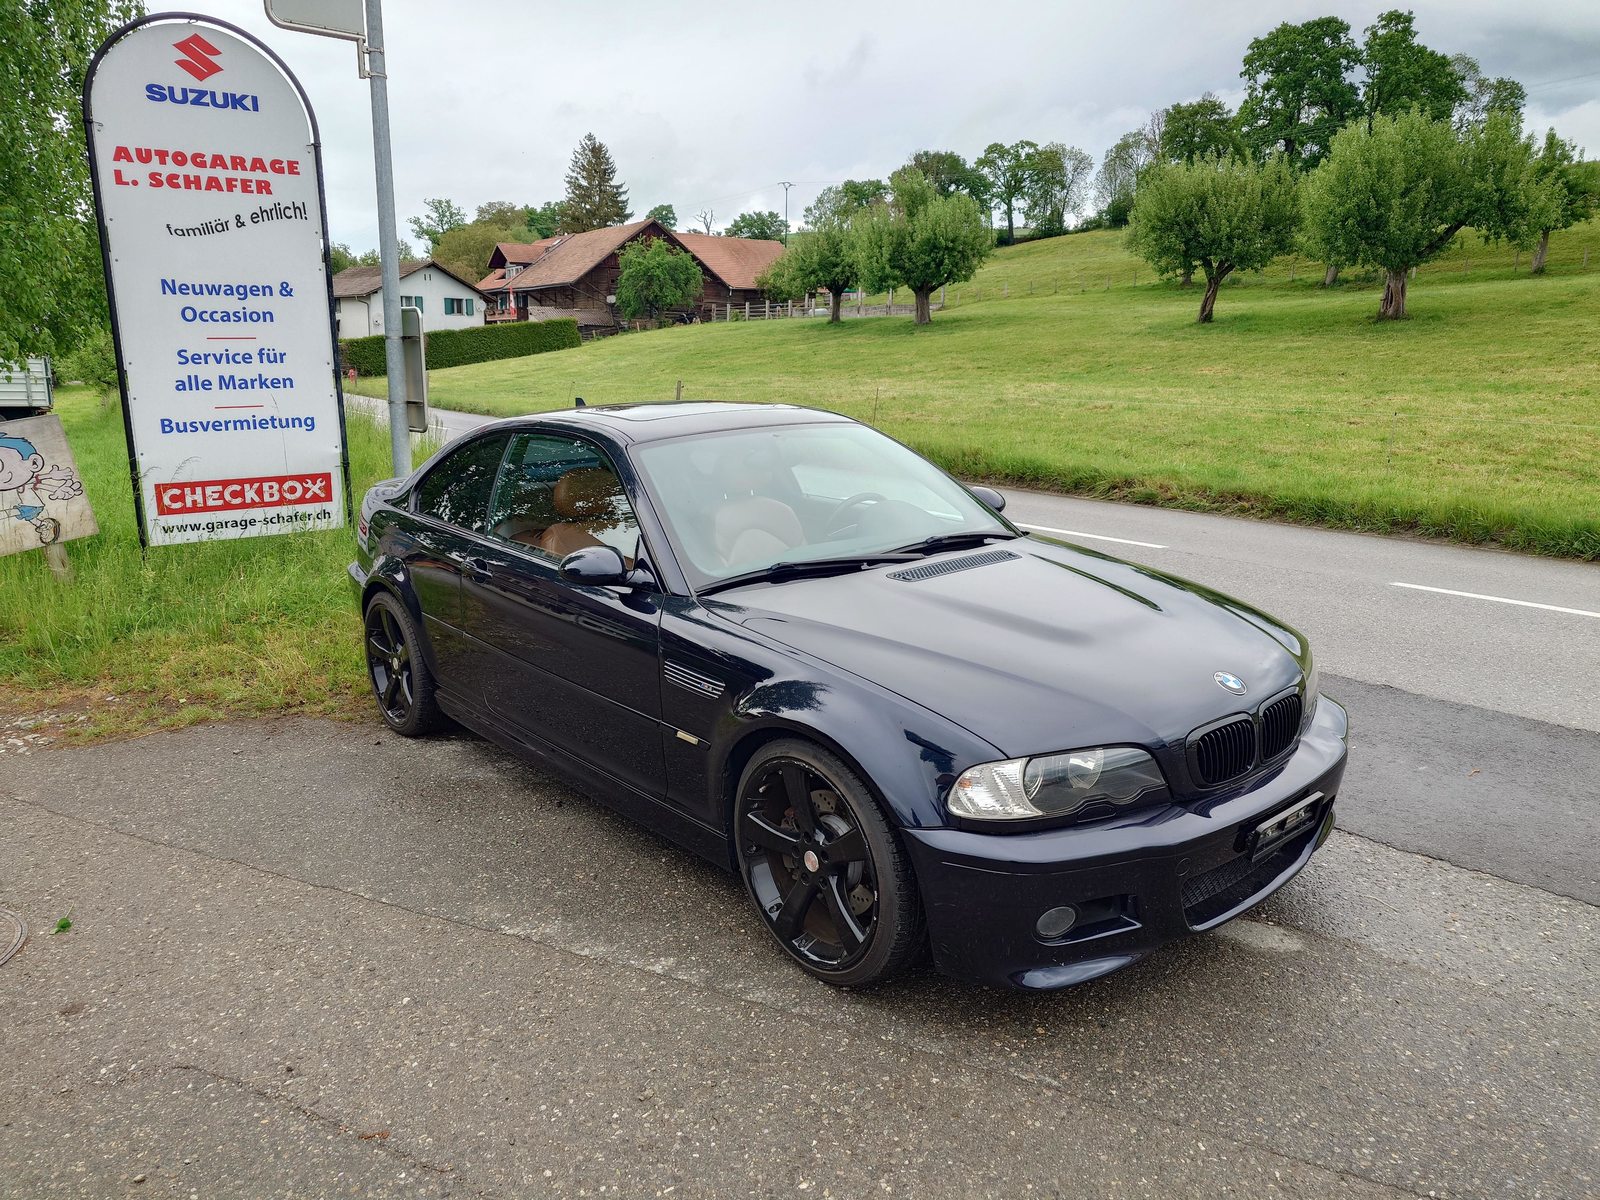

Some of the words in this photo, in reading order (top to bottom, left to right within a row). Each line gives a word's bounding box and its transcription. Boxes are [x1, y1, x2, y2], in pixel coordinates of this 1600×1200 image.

[145, 83, 259, 112] SUZUKI
[113, 146, 301, 175] AUTOGARAGE
[114, 170, 139, 186] L.
[148, 172, 273, 195] SCHAFER
[166, 219, 230, 237] familiär
[235, 214, 246, 228] &
[250, 202, 308, 224] ehrlich!
[160, 279, 273, 300] Neuwagen
[279, 282, 294, 297] &
[180, 307, 275, 323] Occasion
[176, 349, 253, 365] Service
[257, 348, 287, 364] für
[175, 375, 213, 391] alle
[218, 374, 294, 390] Marken
[160, 415, 316, 434] Busvermietung
[163, 477, 326, 510] CHECKBOX
